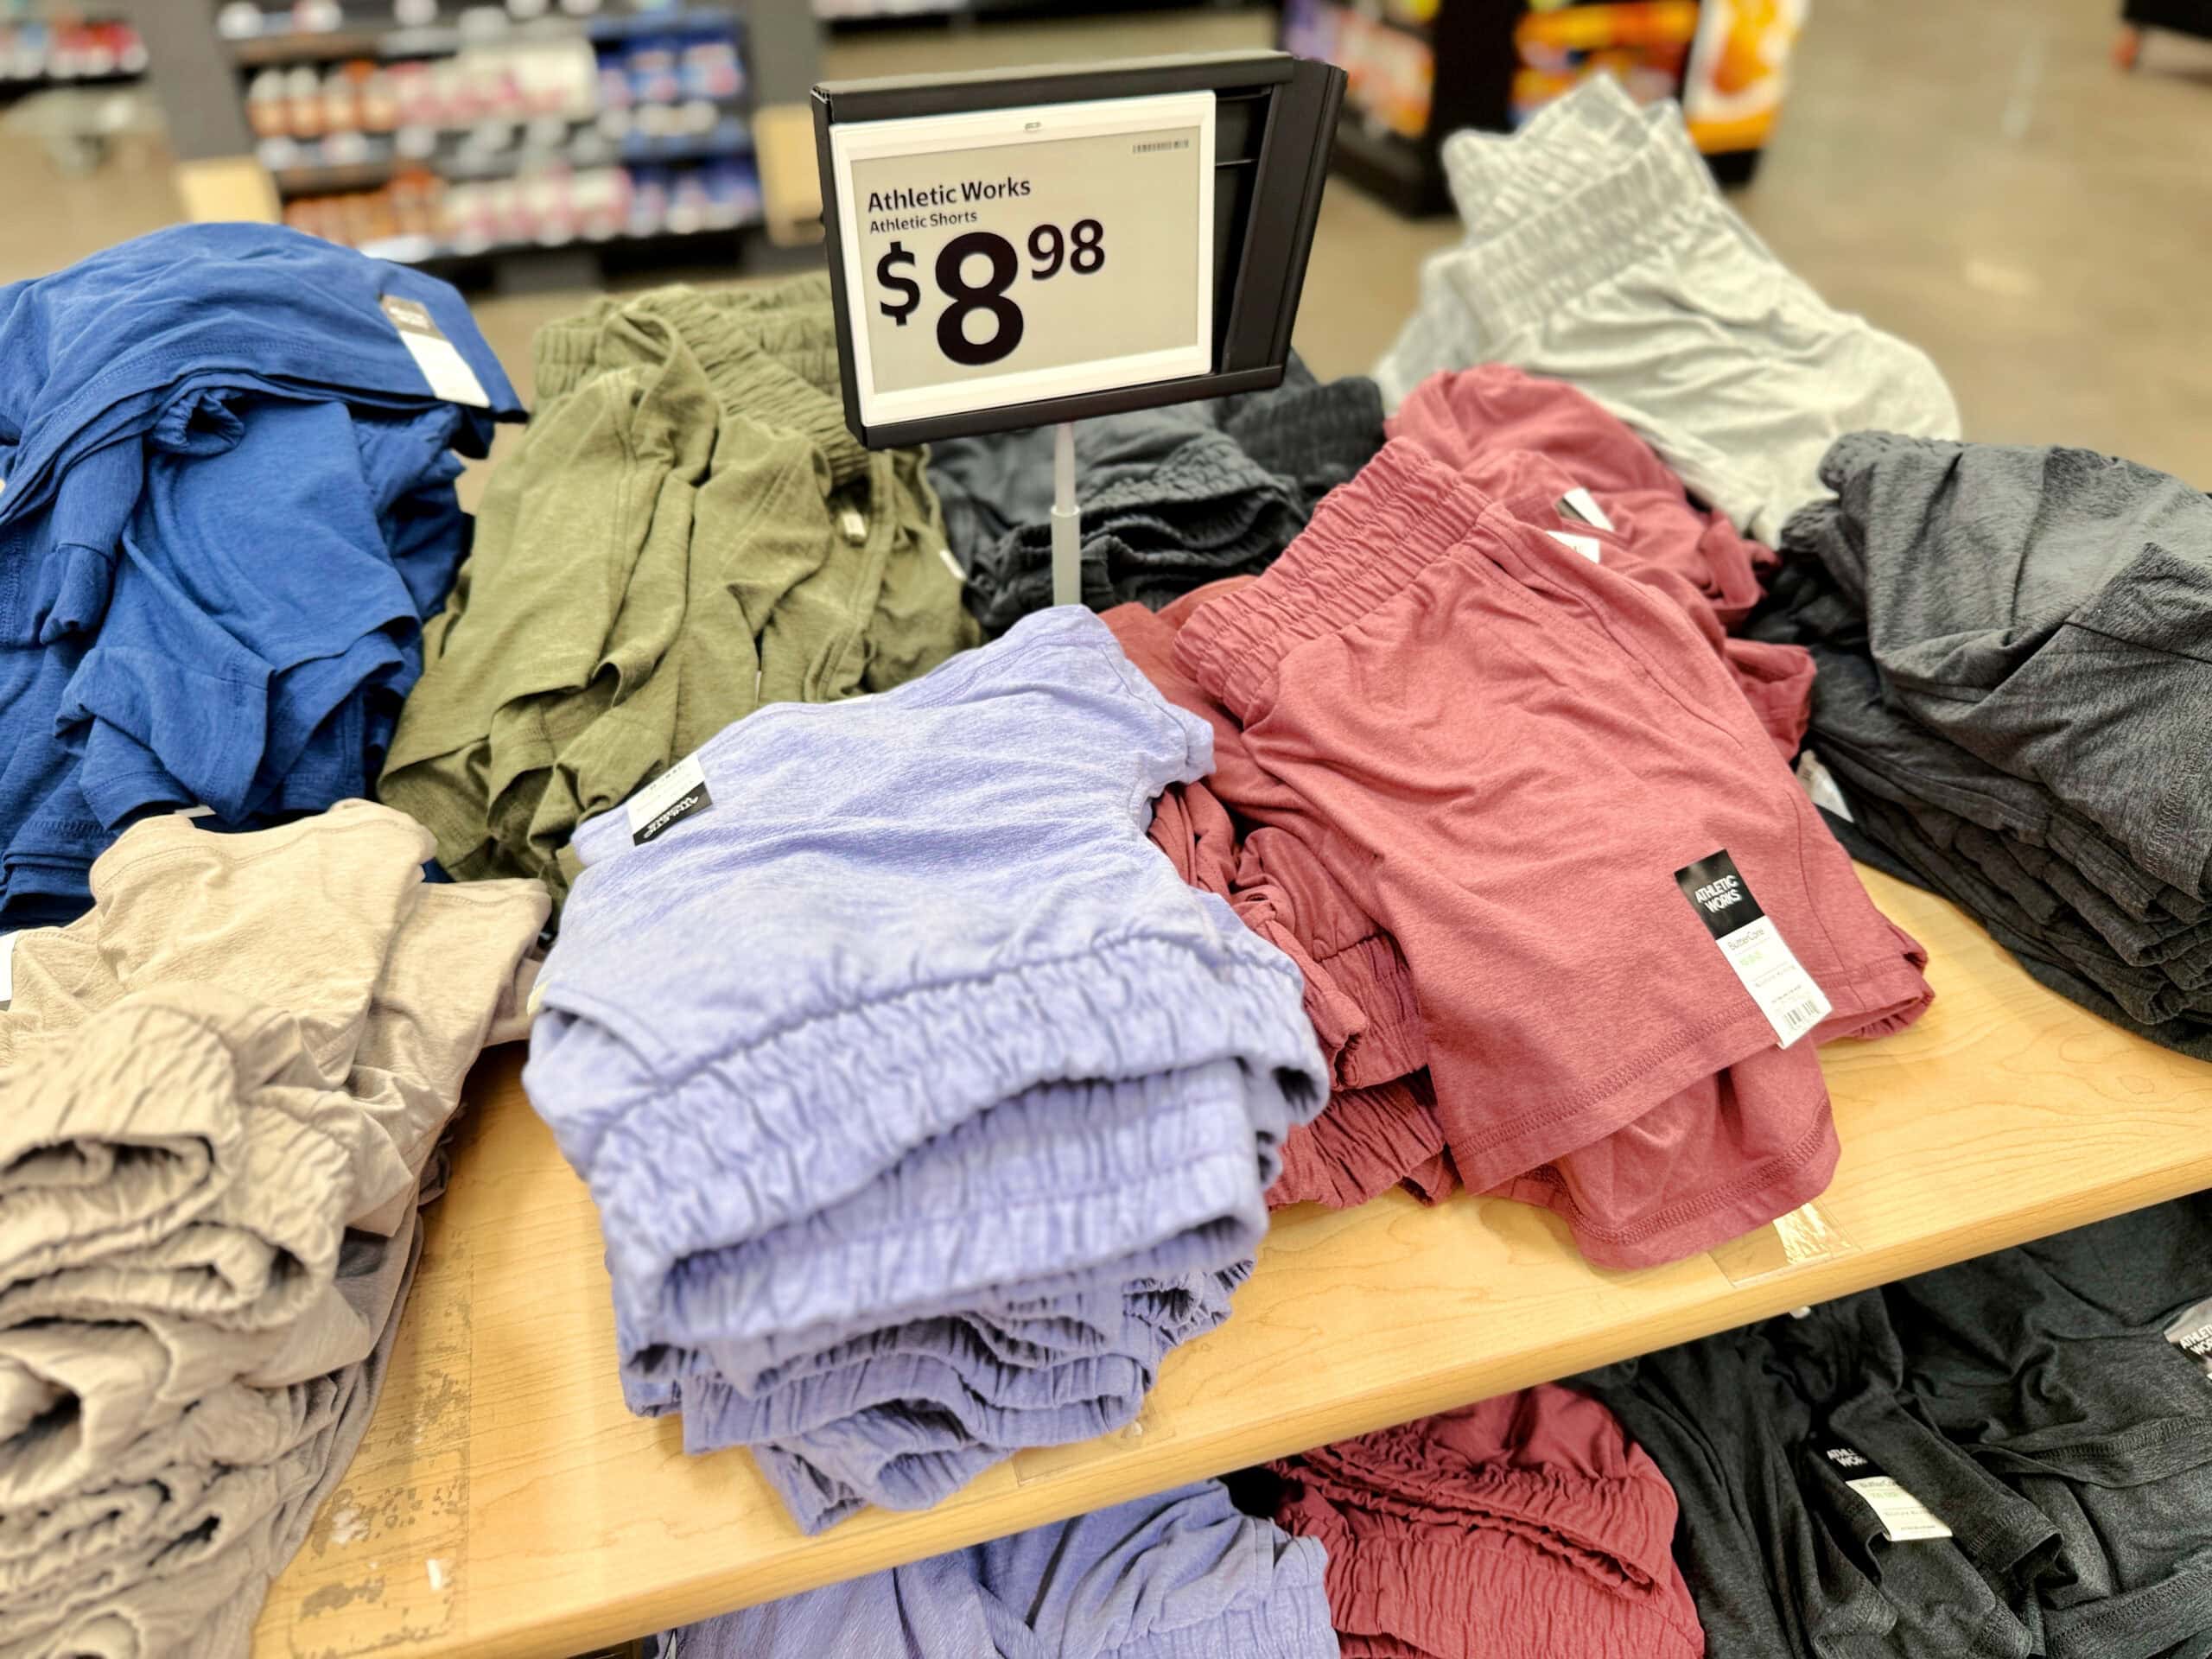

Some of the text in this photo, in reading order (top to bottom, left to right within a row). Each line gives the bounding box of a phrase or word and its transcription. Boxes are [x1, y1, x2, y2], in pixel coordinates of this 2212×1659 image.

[868, 177, 1031, 213] Athletic Works
[869, 210, 978, 234] Athletic Shorts
[1694, 875, 1738, 903] ATHLETIC
[1705, 890, 1742, 912] WORKS
